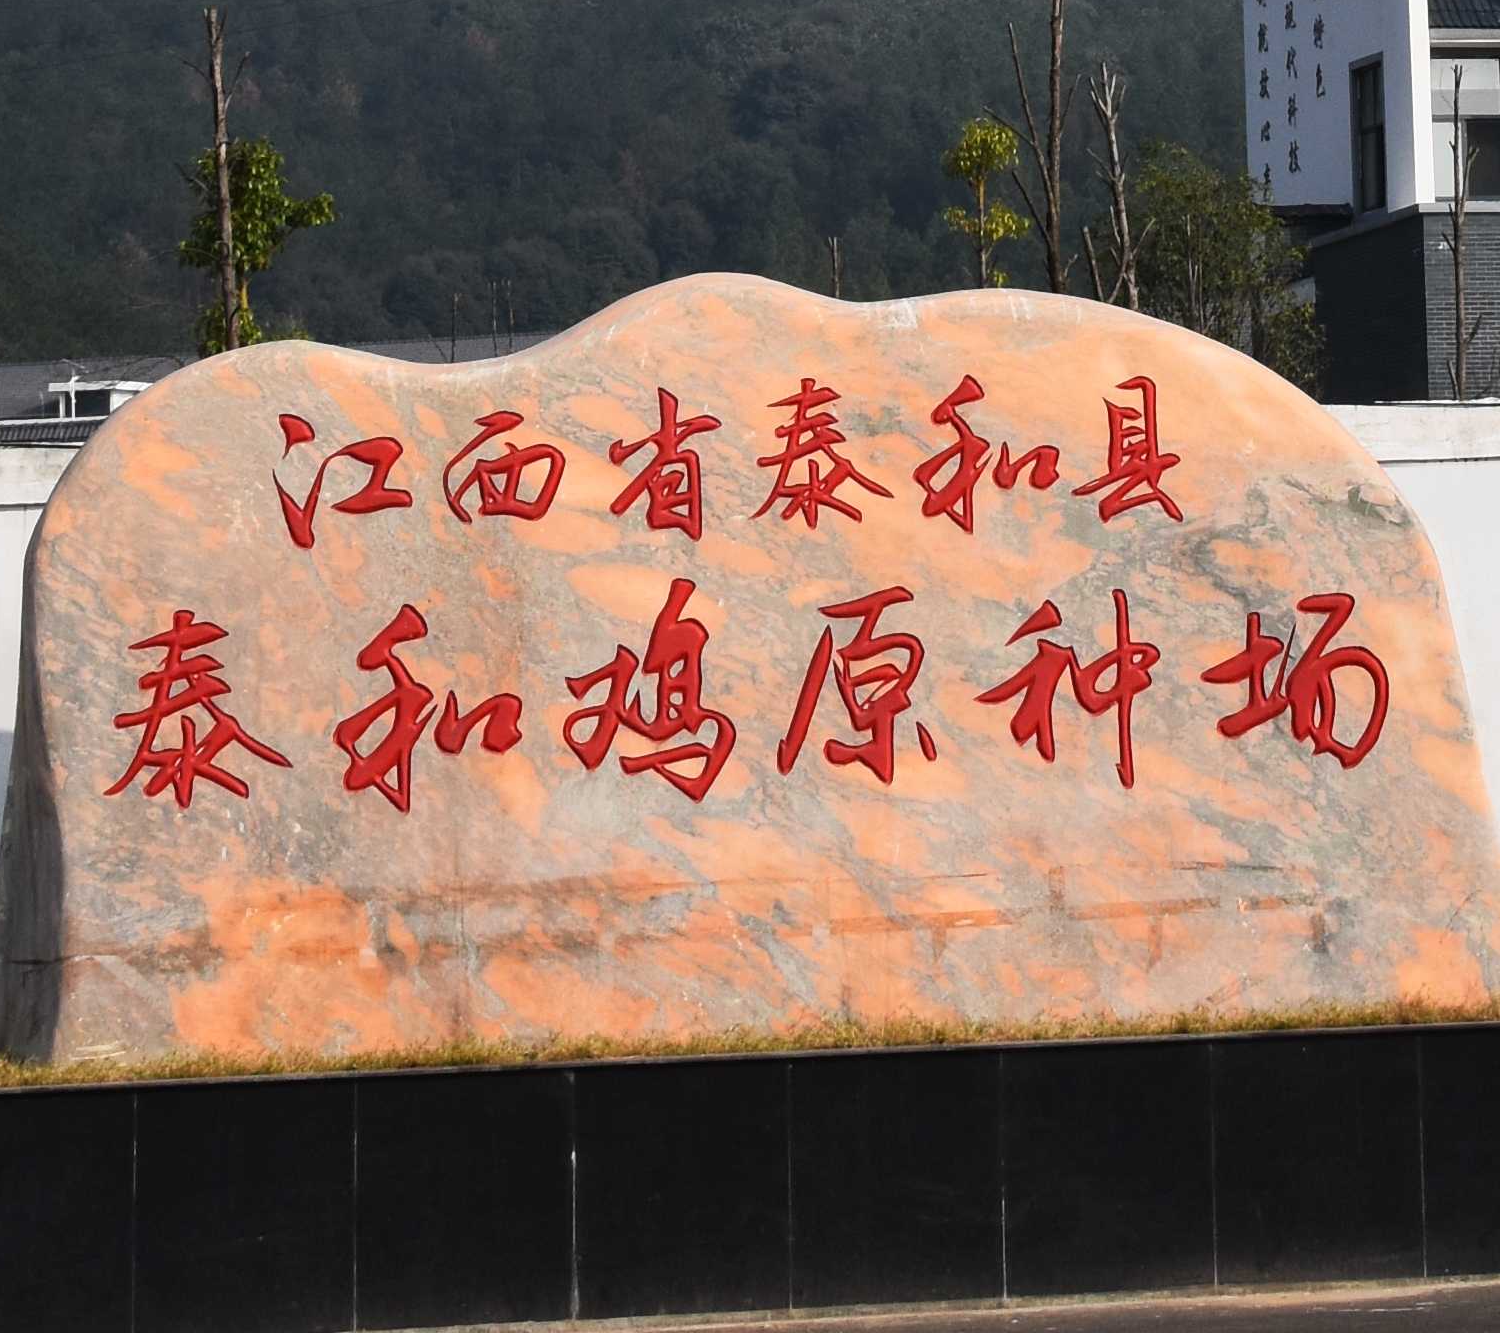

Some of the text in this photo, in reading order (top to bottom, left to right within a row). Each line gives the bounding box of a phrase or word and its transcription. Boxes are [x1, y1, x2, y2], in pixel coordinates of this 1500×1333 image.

[272, 374, 1184, 550] 江西省泰和县
[102, 576, 1390, 815] 泰和鸡原种场
